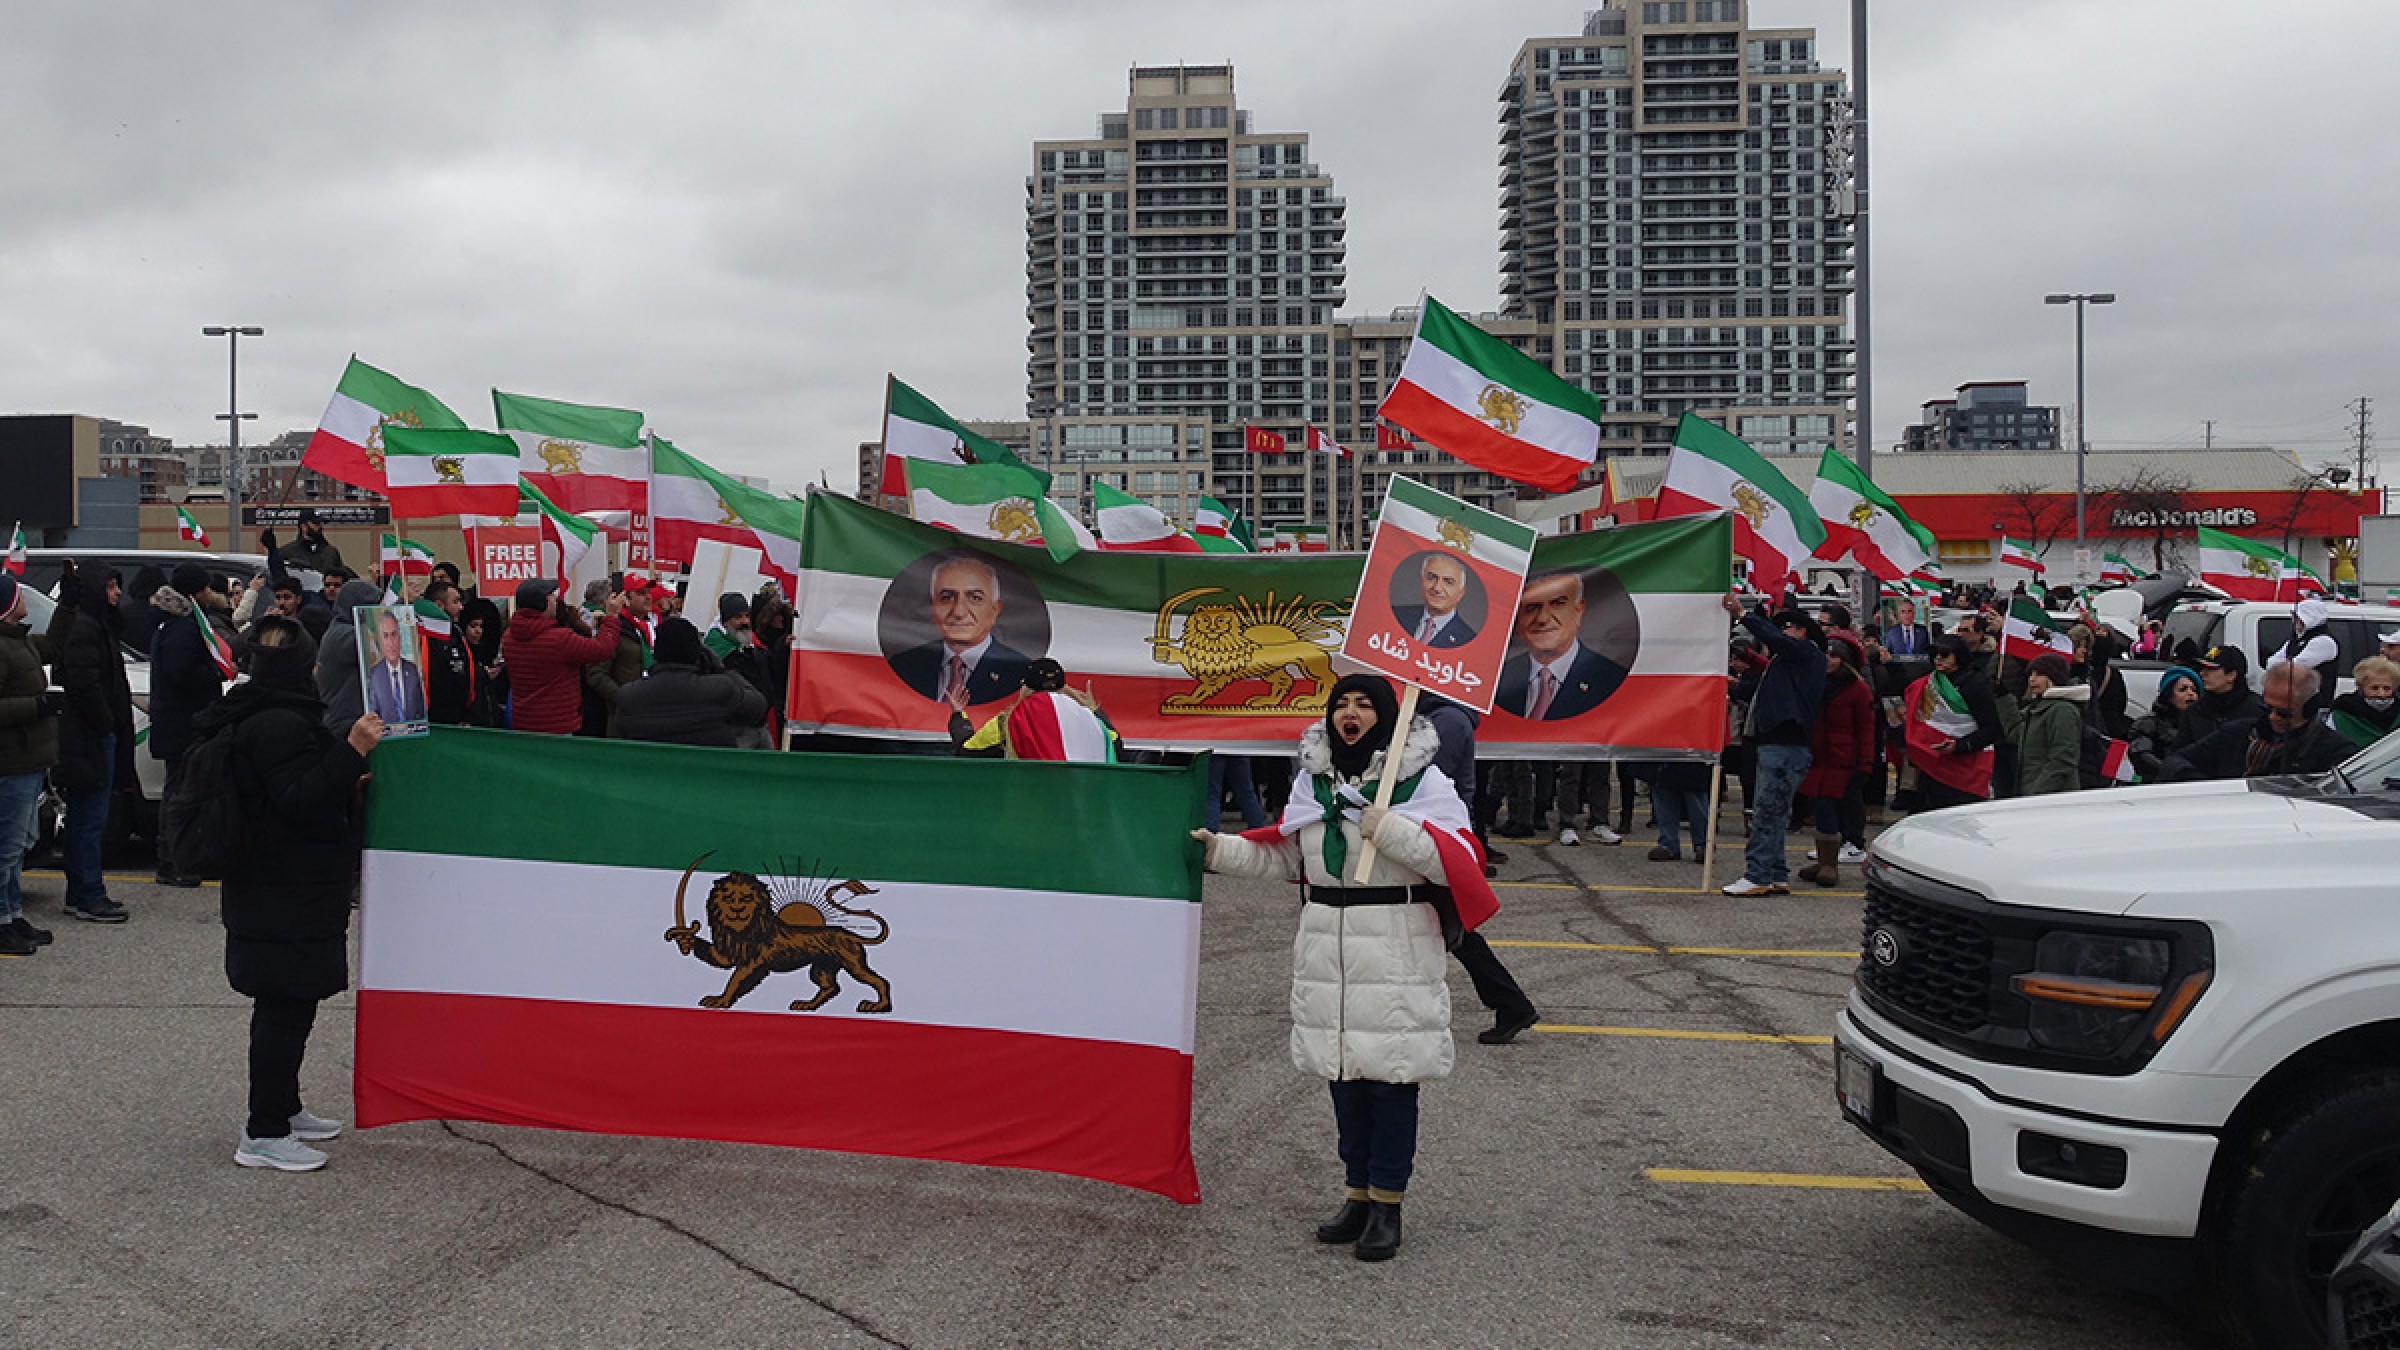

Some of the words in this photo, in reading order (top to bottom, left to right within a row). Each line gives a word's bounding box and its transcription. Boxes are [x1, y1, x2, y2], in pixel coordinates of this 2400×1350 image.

[484, 544, 537, 561] FREE
[485, 563, 537, 580] IRAN
[1368, 631, 1409, 661] شاه
[1415, 651, 1482, 693] جاوید
